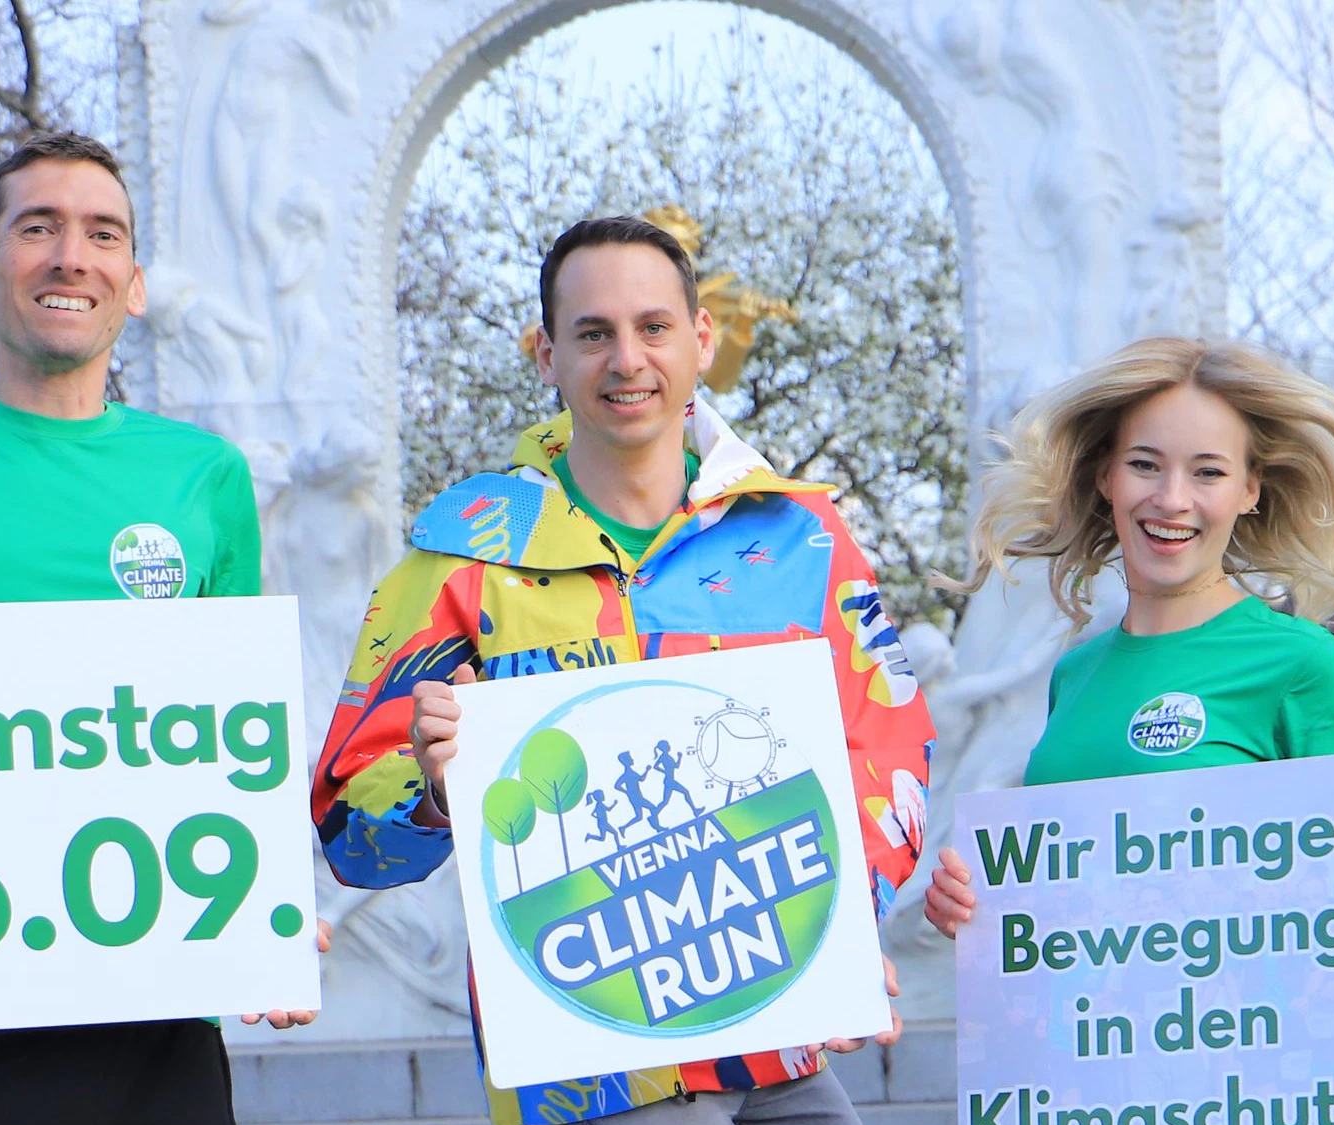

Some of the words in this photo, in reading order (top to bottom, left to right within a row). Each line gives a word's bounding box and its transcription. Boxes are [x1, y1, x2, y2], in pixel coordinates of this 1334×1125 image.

[123, 568, 182, 585] CLIMATE
[139, 559, 166, 567] VIENNA
[143, 583, 171, 598] RUN
[1133, 723, 1197, 739] CLIMATE
[1146, 735, 1178, 748] RUN
[599, 819, 726, 888] VIENNA
[975, 821, 1095, 887] Wir
[542, 820, 827, 983] CLIMATE
[640, 910, 784, 1020] RUN
[1076, 997, 1133, 1057] in
[1154, 987, 1279, 1052] den
